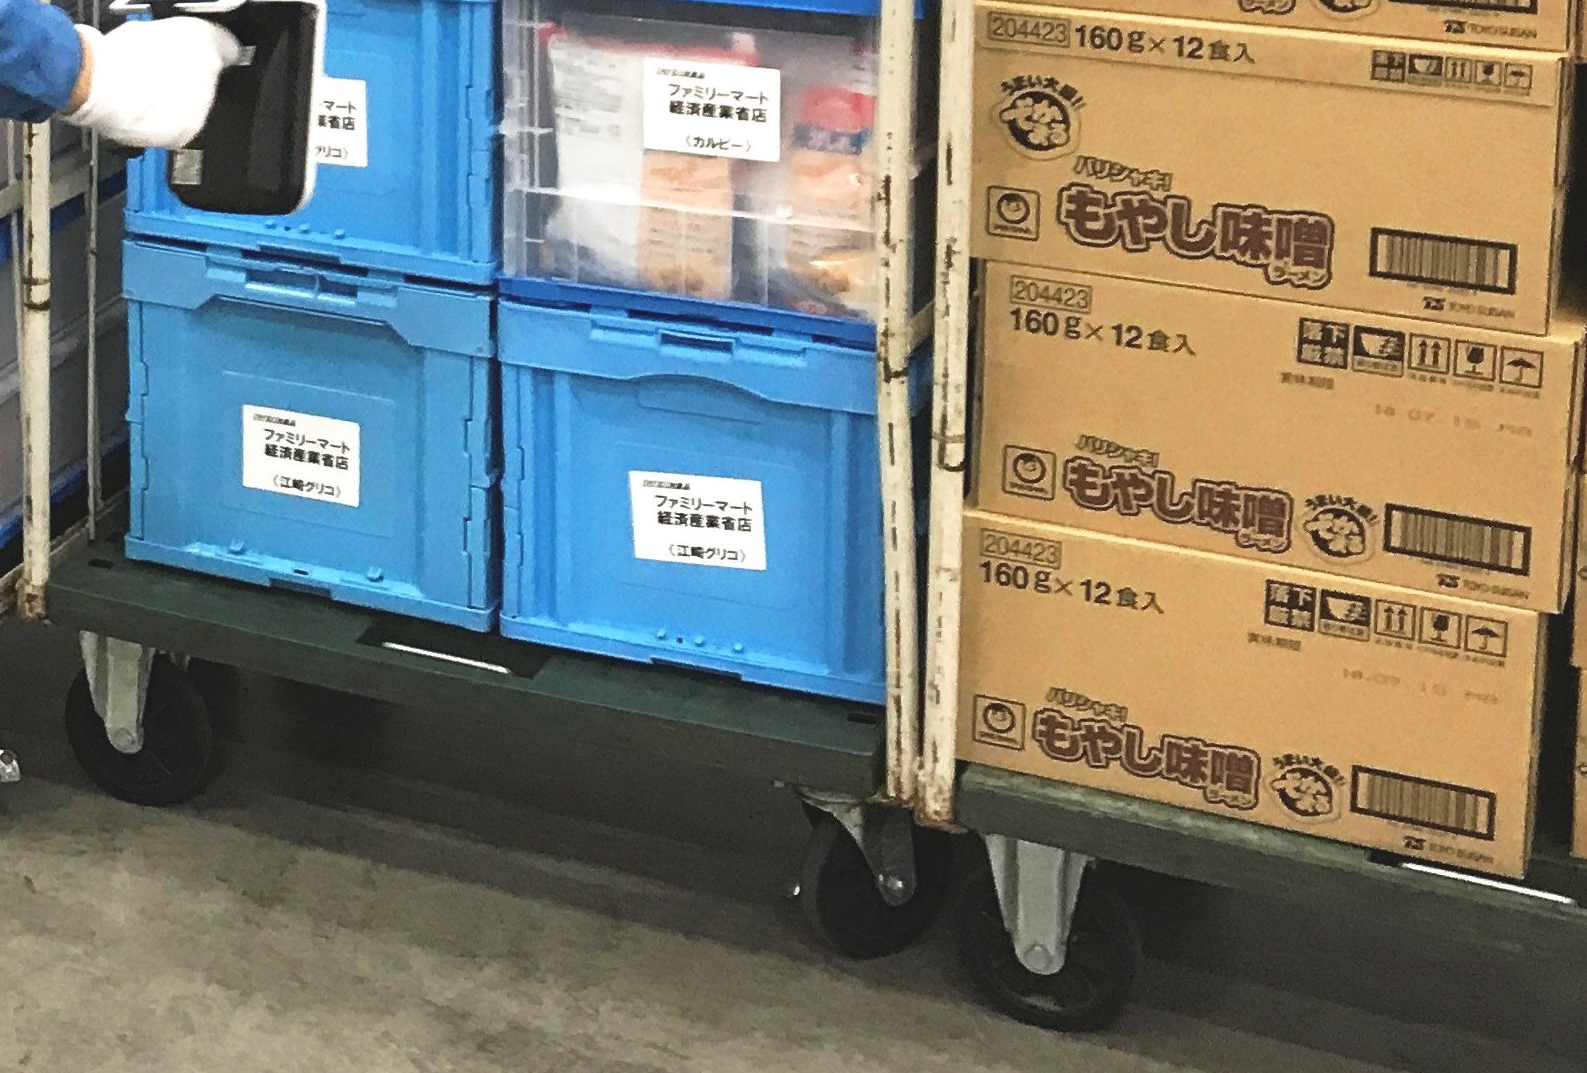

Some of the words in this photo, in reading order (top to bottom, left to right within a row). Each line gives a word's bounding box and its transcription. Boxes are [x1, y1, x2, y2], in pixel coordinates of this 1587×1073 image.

[992, 16, 1068, 45] 204423
[668, 83, 770, 105] ファミリーマート
[669, 100, 768, 123] 経済産業省店
[1061, 185, 1332, 270] もやし味噌
[1013, 280, 1089, 309] 204423
[263, 428, 351, 454] ファミリーマート
[264, 443, 349, 471] 経済産業省店
[655, 494, 753, 516] ファミリーマート
[1065, 458, 1292, 537] もやし味噌
[657, 511, 752, 532] 経済産業省店
[983, 533, 1061, 565] 204423
[1035, 710, 1258, 794] もやし味噌
